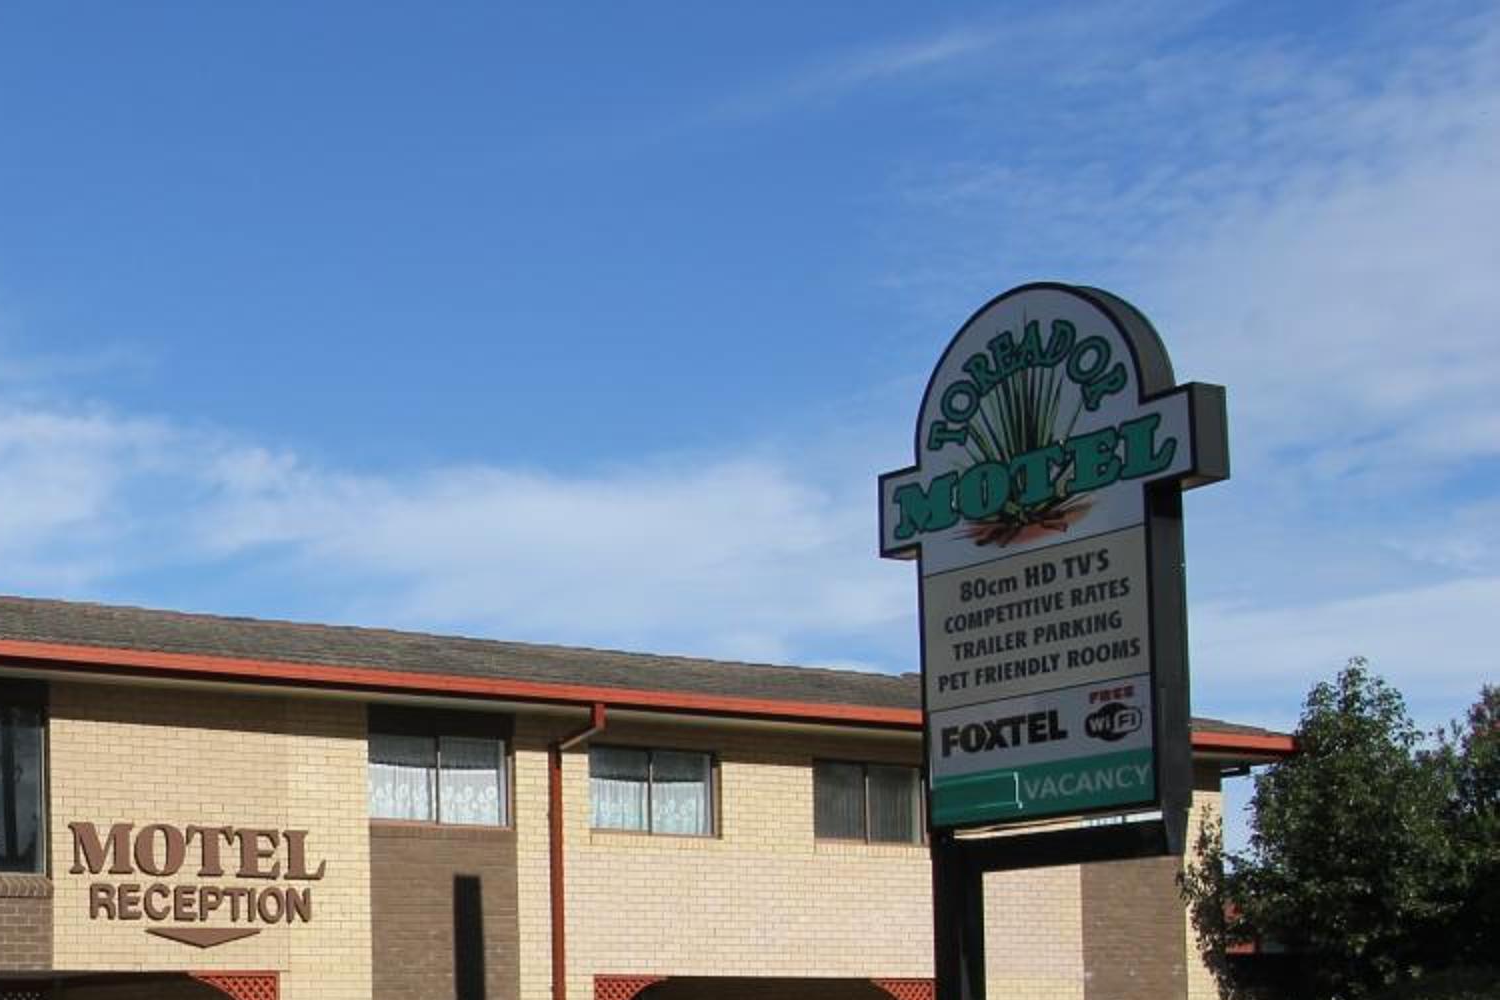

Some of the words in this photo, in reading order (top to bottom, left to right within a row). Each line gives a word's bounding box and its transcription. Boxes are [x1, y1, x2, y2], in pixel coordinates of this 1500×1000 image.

[928, 319, 1127, 451] TOREADOR
[893, 413, 1177, 540] MOTEL
[960, 574, 1018, 602] 80cm
[1024, 562, 1057, 588] HD
[1063, 549, 1110, 580] TV'S
[944, 590, 1065, 635] COMPETITIVE
[1071, 576, 1131, 608] RATES
[953, 629, 1028, 662] TRAILER
[1033, 609, 1123, 646] PARKING
[938, 670, 969, 693] PET
[975, 653, 1061, 686] FRIENDLY
[1067, 637, 1141, 669] ROOMS
[1089, 684, 1135, 704] FREE
[941, 709, 1068, 757] FOXTEL
[1023, 763, 1151, 800] VACANCY
[67, 821, 327, 881] MOTEL
[89, 883, 312, 924] RECEPTION
